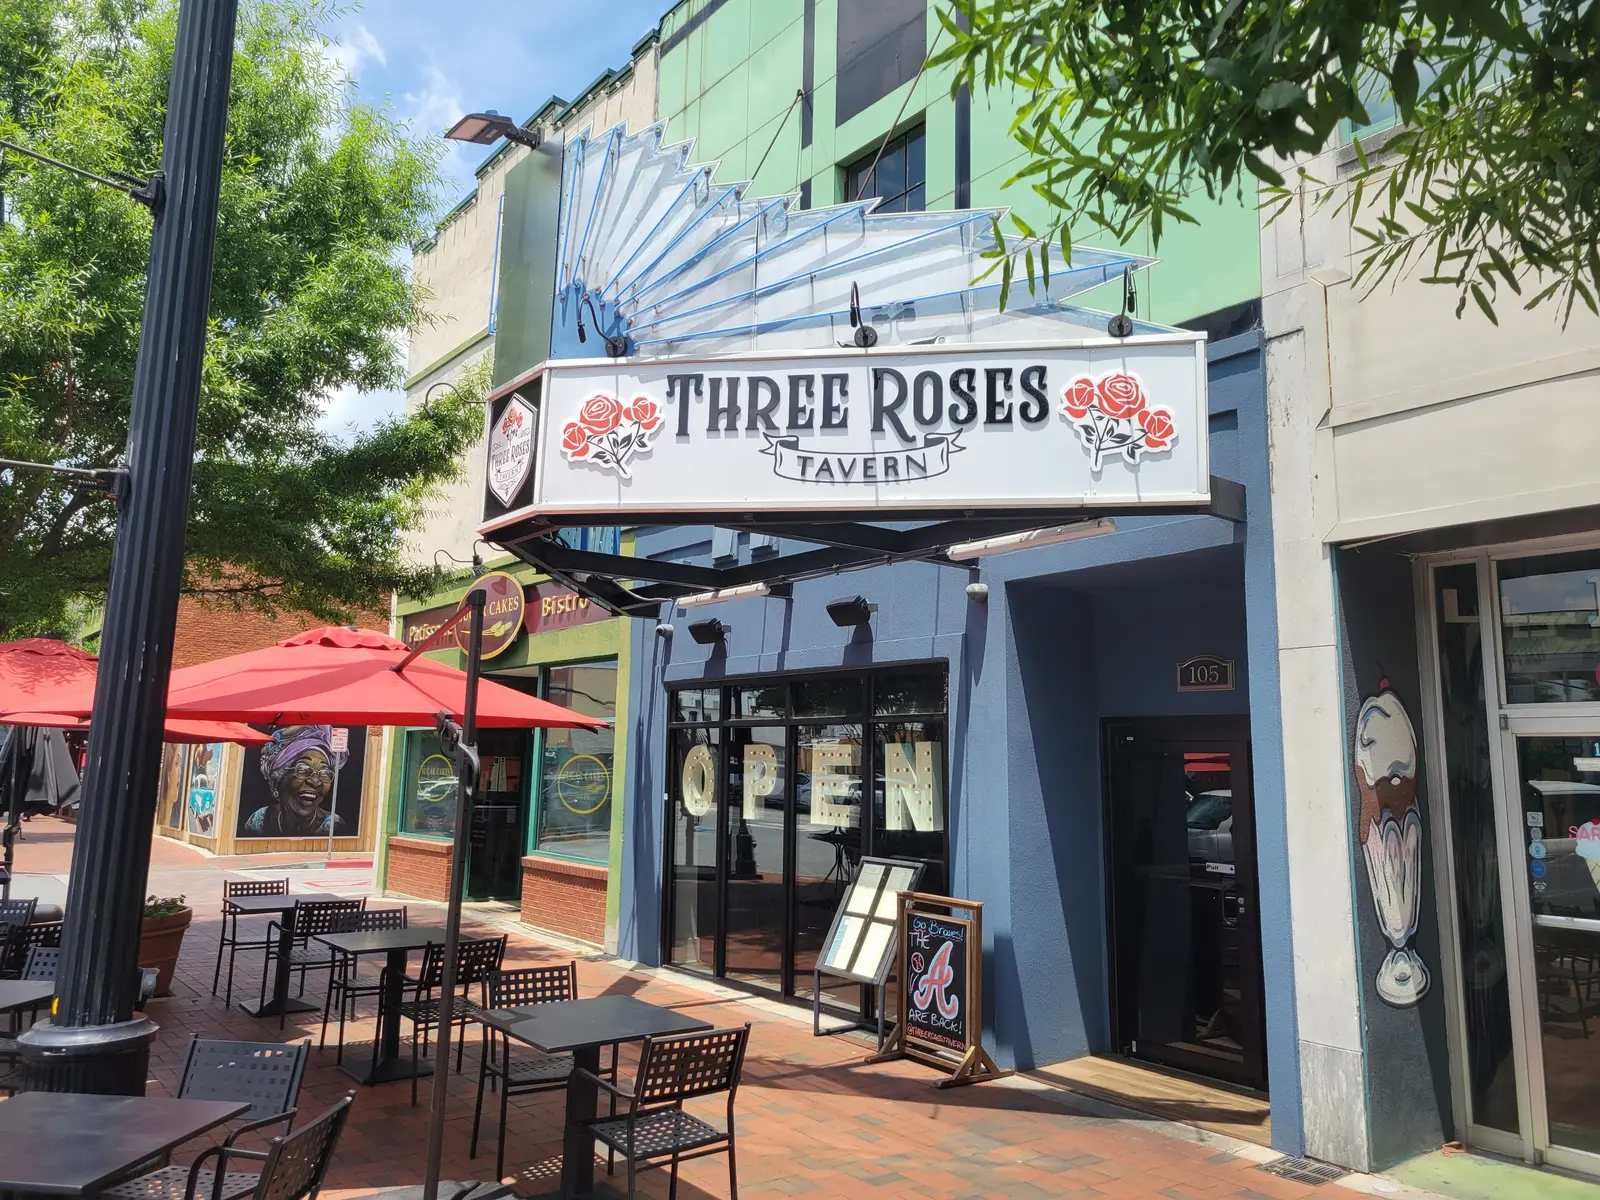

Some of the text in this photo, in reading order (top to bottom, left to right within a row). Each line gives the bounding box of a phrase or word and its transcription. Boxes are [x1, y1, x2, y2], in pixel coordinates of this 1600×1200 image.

[666, 364, 1050, 444] THREE ROSES
[491, 440, 530, 471] THREE ROSES
[797, 453, 927, 479] TAVERN
[499, 469, 519, 480] TAVERN
[489, 595, 519, 616] CAKES
[541, 593, 588, 617] Bistro
[1189, 665, 1220, 683] 105
[682, 742, 944, 832] OPEN
[909, 931, 930, 949] THE
[913, 917, 964, 941] Go Braves!
[908, 1008, 963, 1035] ARE BACK!
